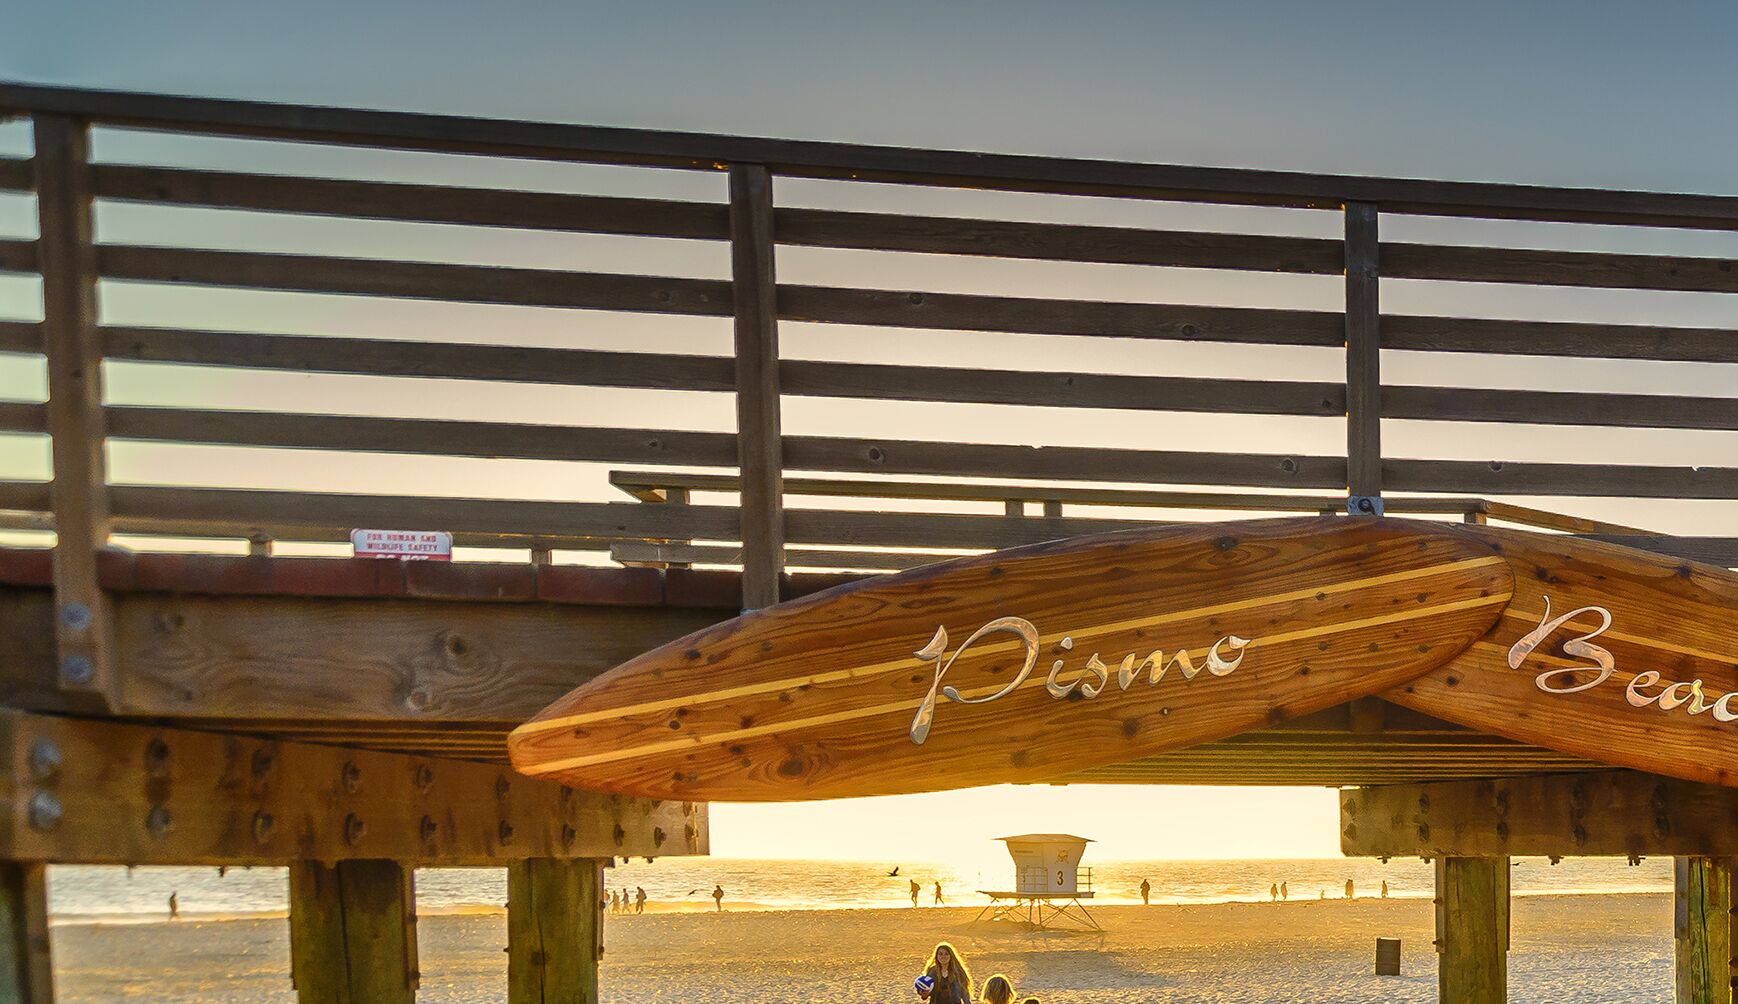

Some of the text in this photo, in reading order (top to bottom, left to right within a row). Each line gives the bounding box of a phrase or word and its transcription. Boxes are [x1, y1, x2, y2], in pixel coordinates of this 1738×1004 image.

[387, 534, 416, 542] HUMAN
[368, 543, 438, 552] WILDLIFE SAFETY
[909, 616, 1253, 745] Pismo
[1057, 870, 1064, 886] 3
